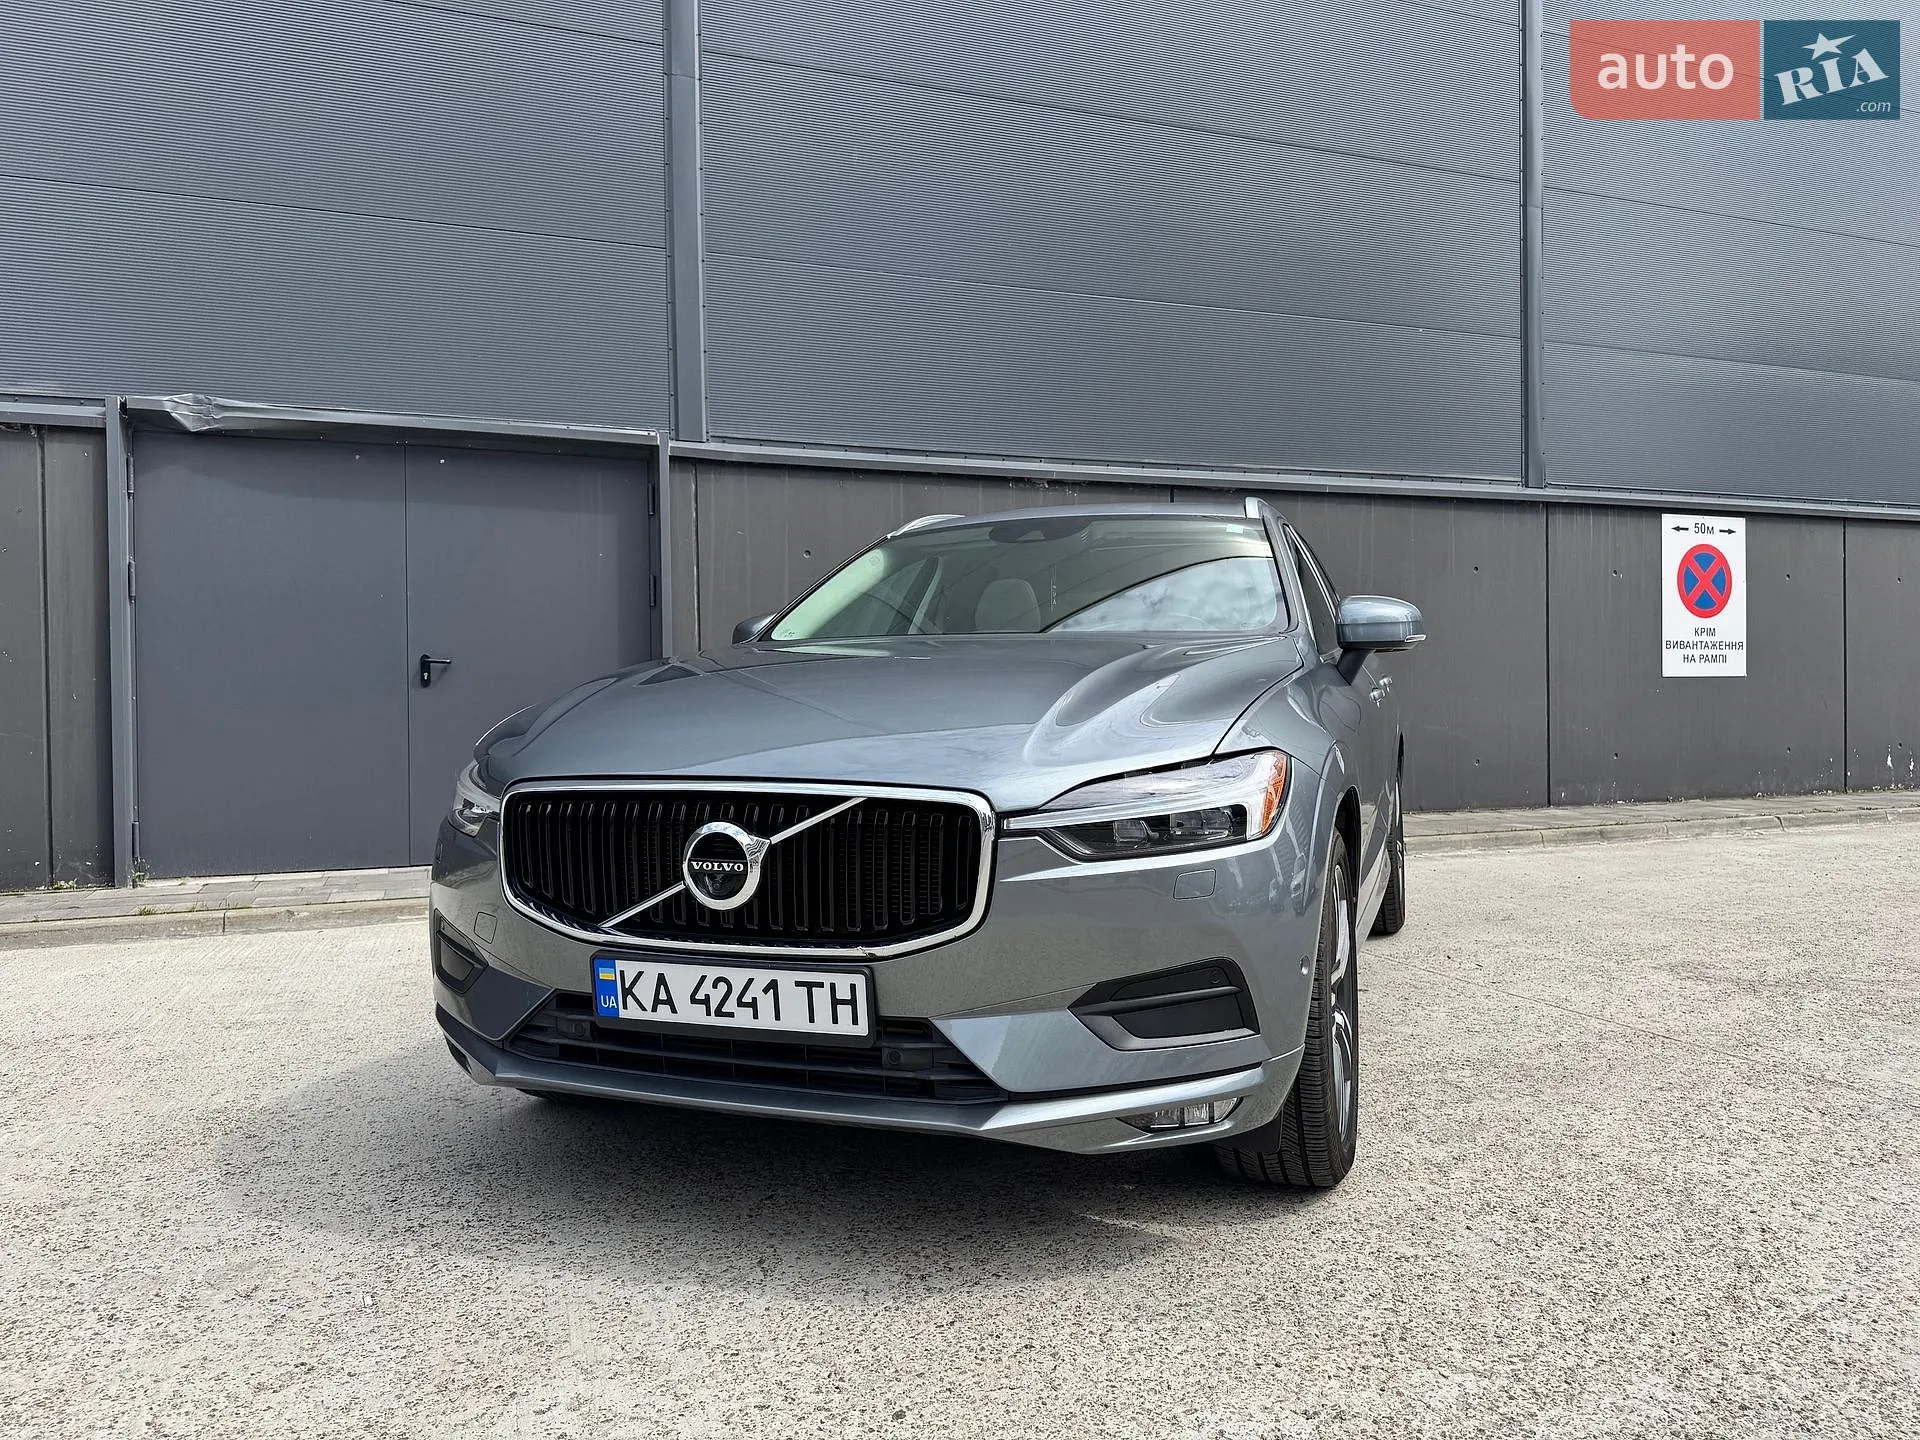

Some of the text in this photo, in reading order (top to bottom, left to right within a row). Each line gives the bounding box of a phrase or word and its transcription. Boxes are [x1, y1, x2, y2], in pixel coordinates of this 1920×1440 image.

[1694, 627, 1716, 637] КРІМ
[1665, 640, 1744, 651] ВИВАНТАЖЕННЯ
[1683, 654, 1727, 664] НА РАМПІ
[690, 861, 744, 872] VOLVO
[601, 995, 618, 1009] UA
[619, 969, 859, 1026] KA 4241 TH
